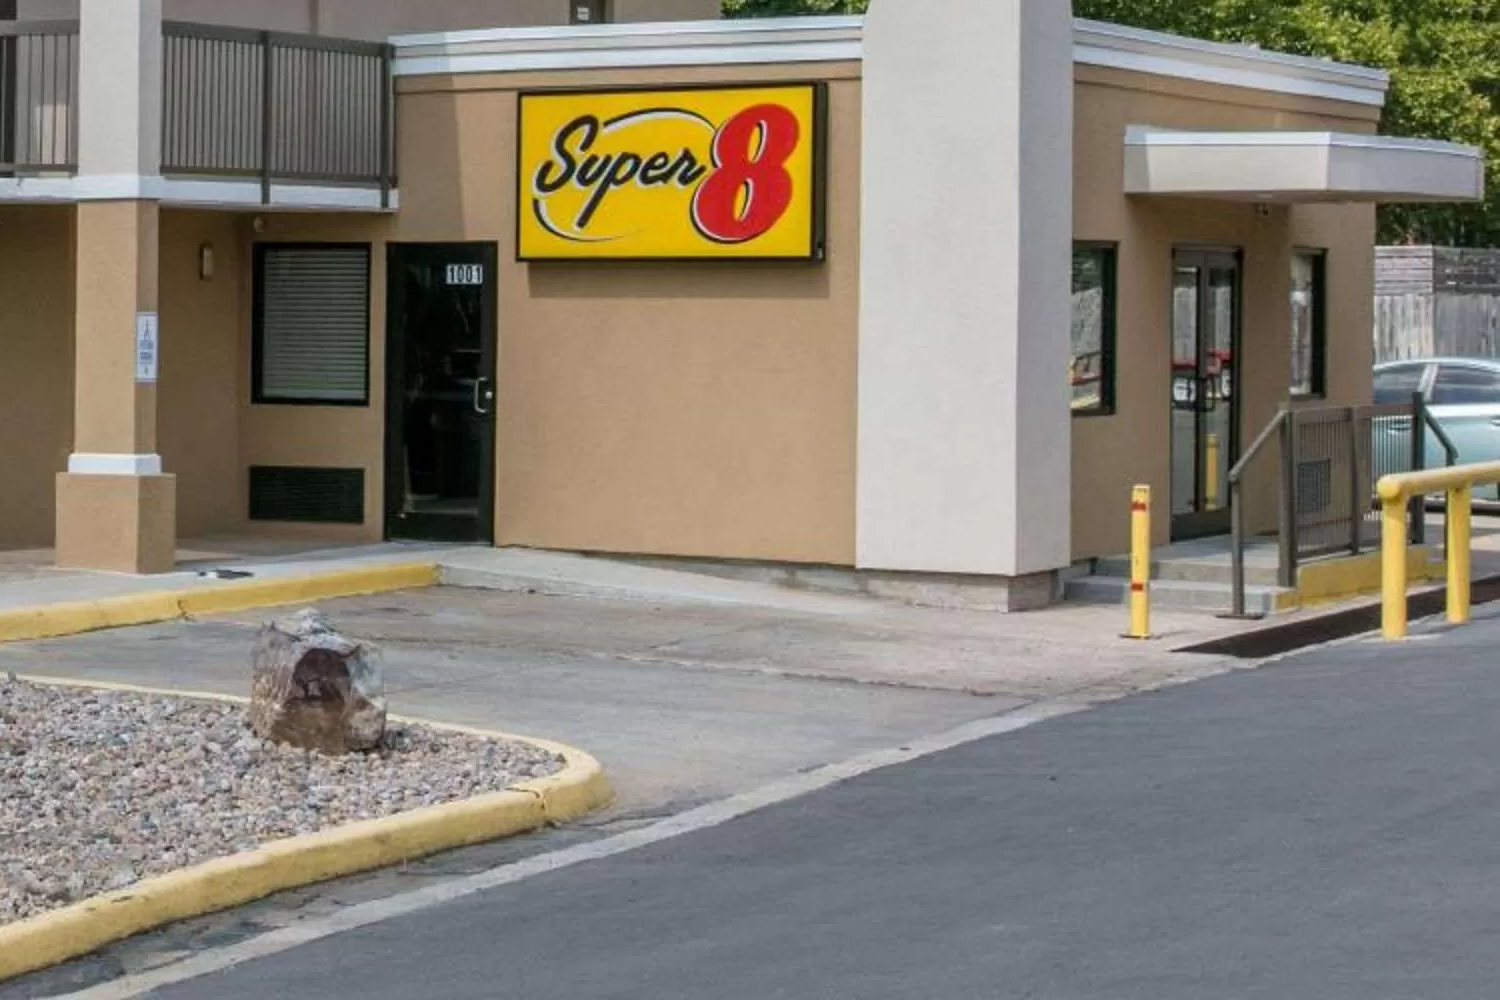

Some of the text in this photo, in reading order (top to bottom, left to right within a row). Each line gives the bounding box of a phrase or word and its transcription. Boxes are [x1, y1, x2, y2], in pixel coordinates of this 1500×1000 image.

[534, 102, 800, 244] Super 8
[449, 265, 481, 283] 1001
